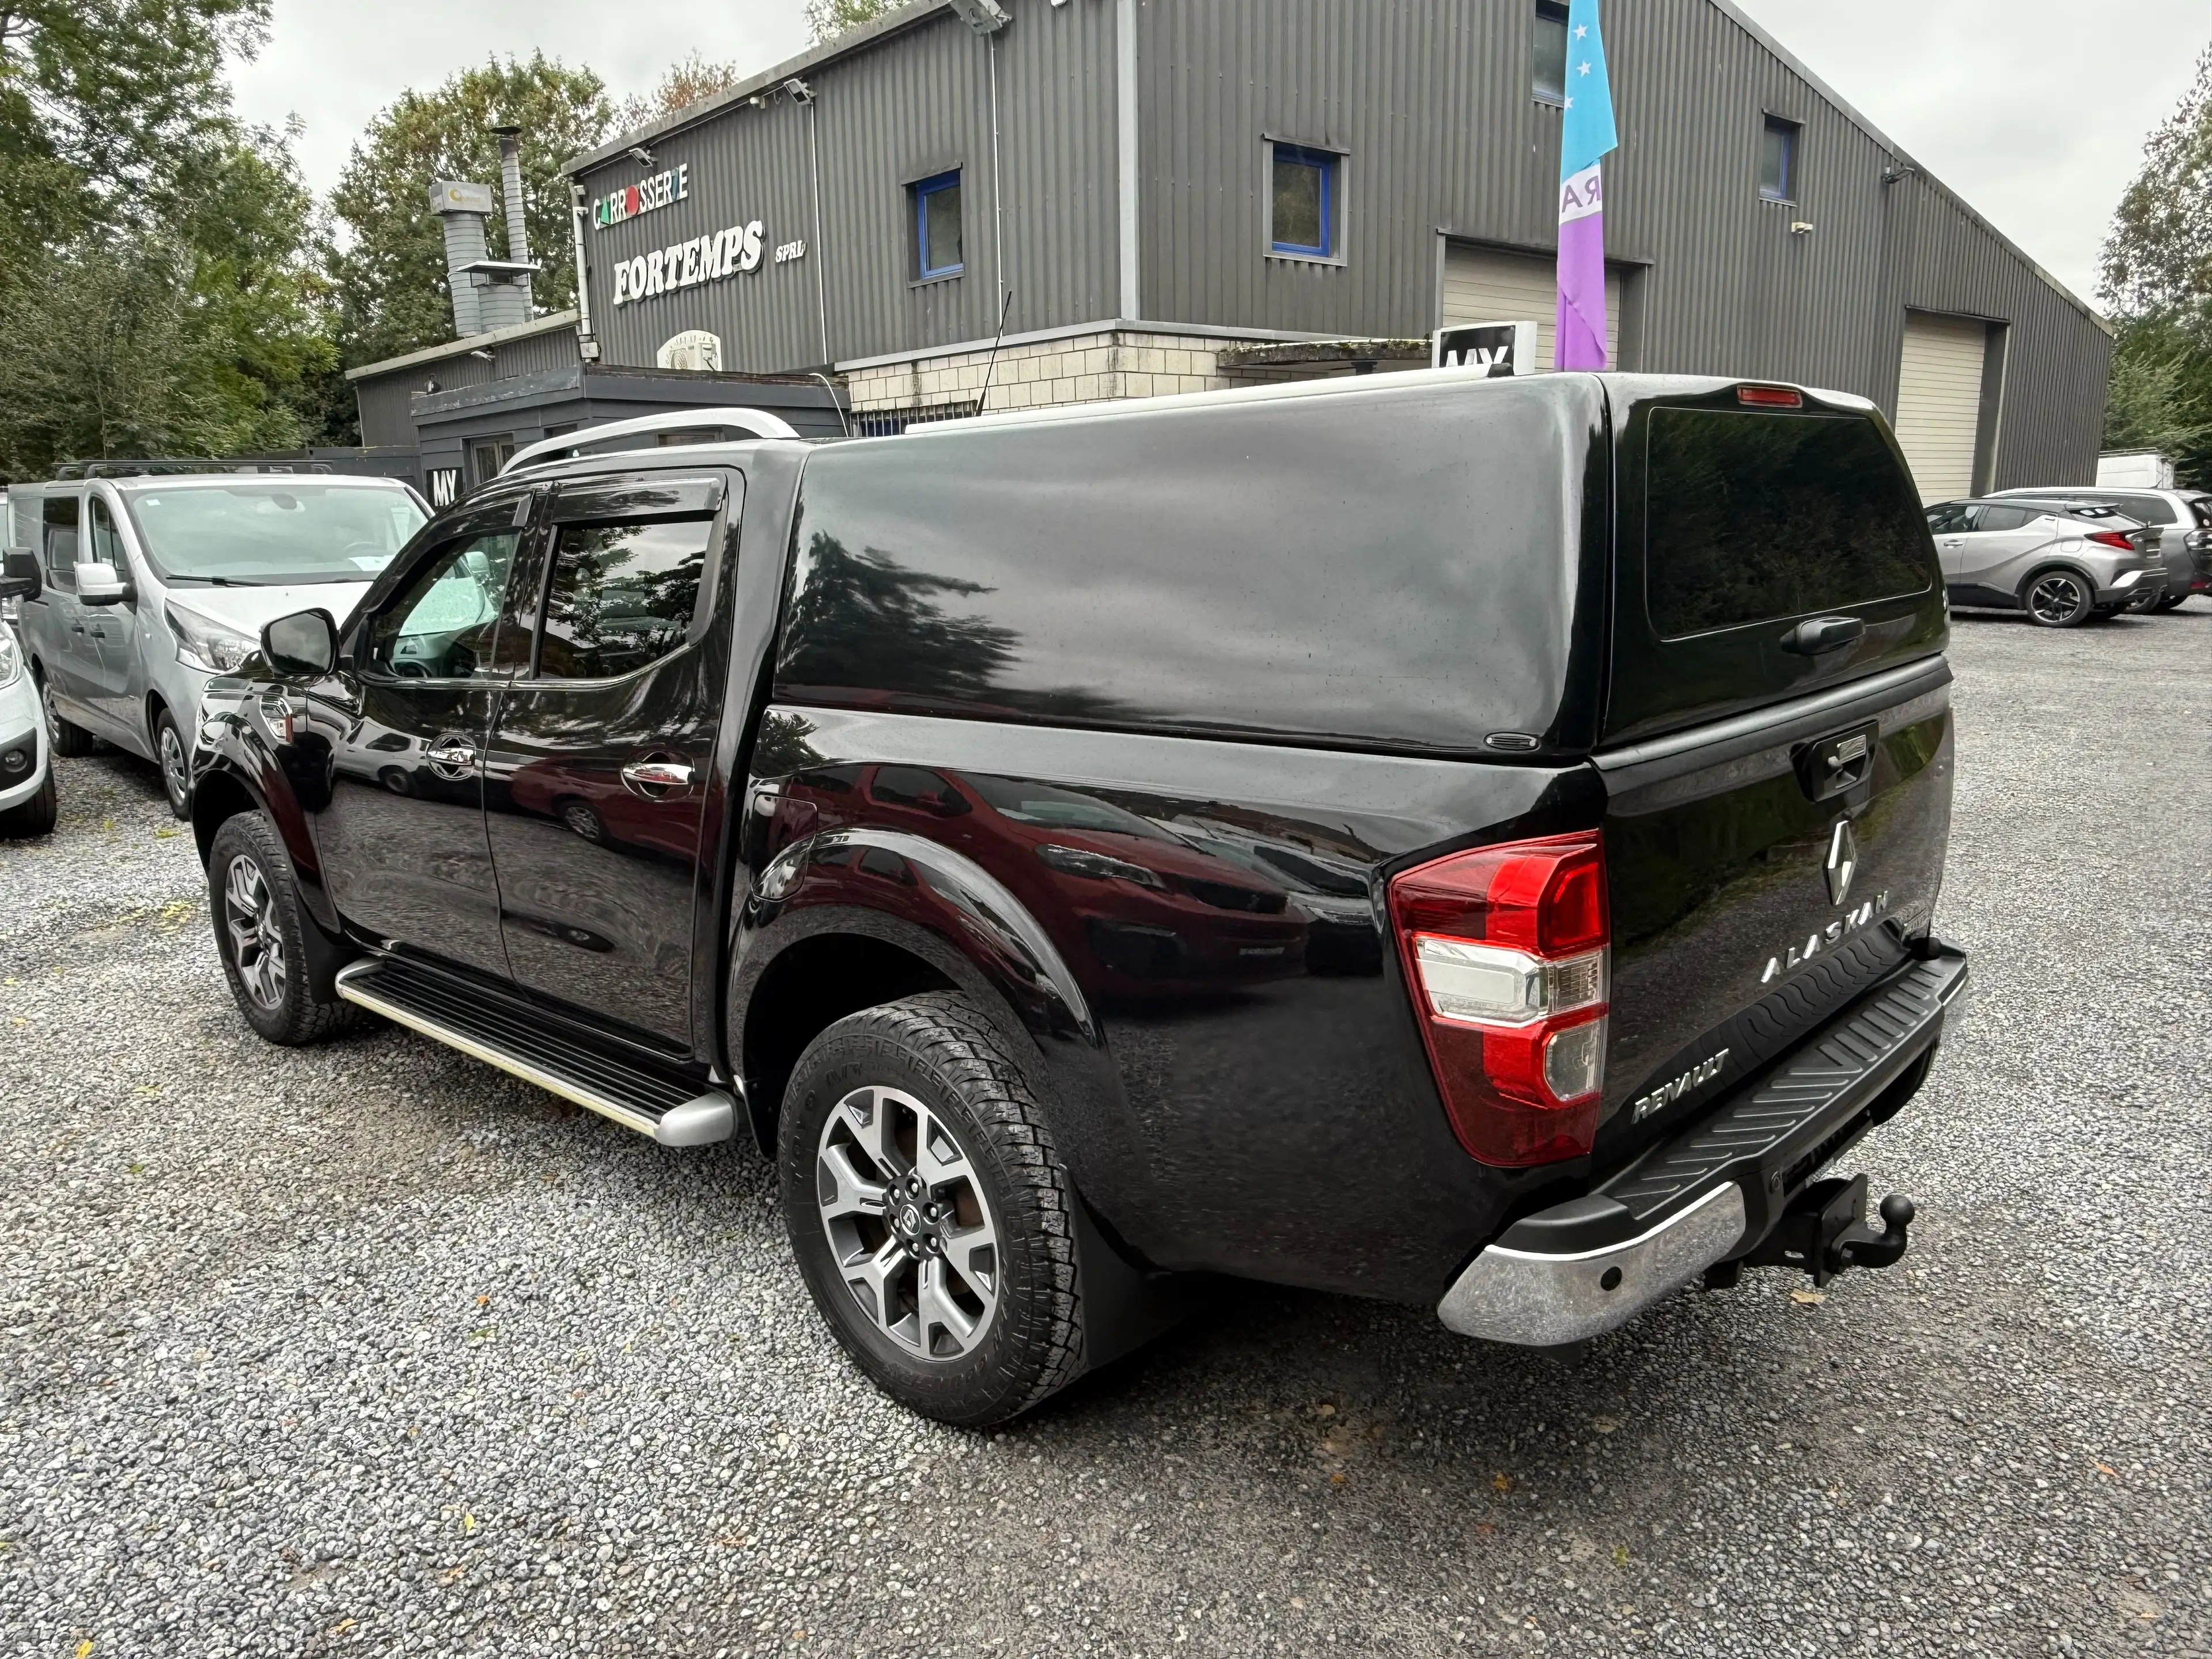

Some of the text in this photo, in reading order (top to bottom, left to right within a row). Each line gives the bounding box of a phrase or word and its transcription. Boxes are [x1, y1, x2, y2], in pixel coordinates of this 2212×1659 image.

[593, 163, 688, 230] CARROSSERIE
[613, 219, 805, 305] FORTEMPS SPRL
[433, 469, 456, 506] MY
[1761, 891, 1889, 983] ALASKAN
[1631, 1048, 1729, 1124] RENAULT
